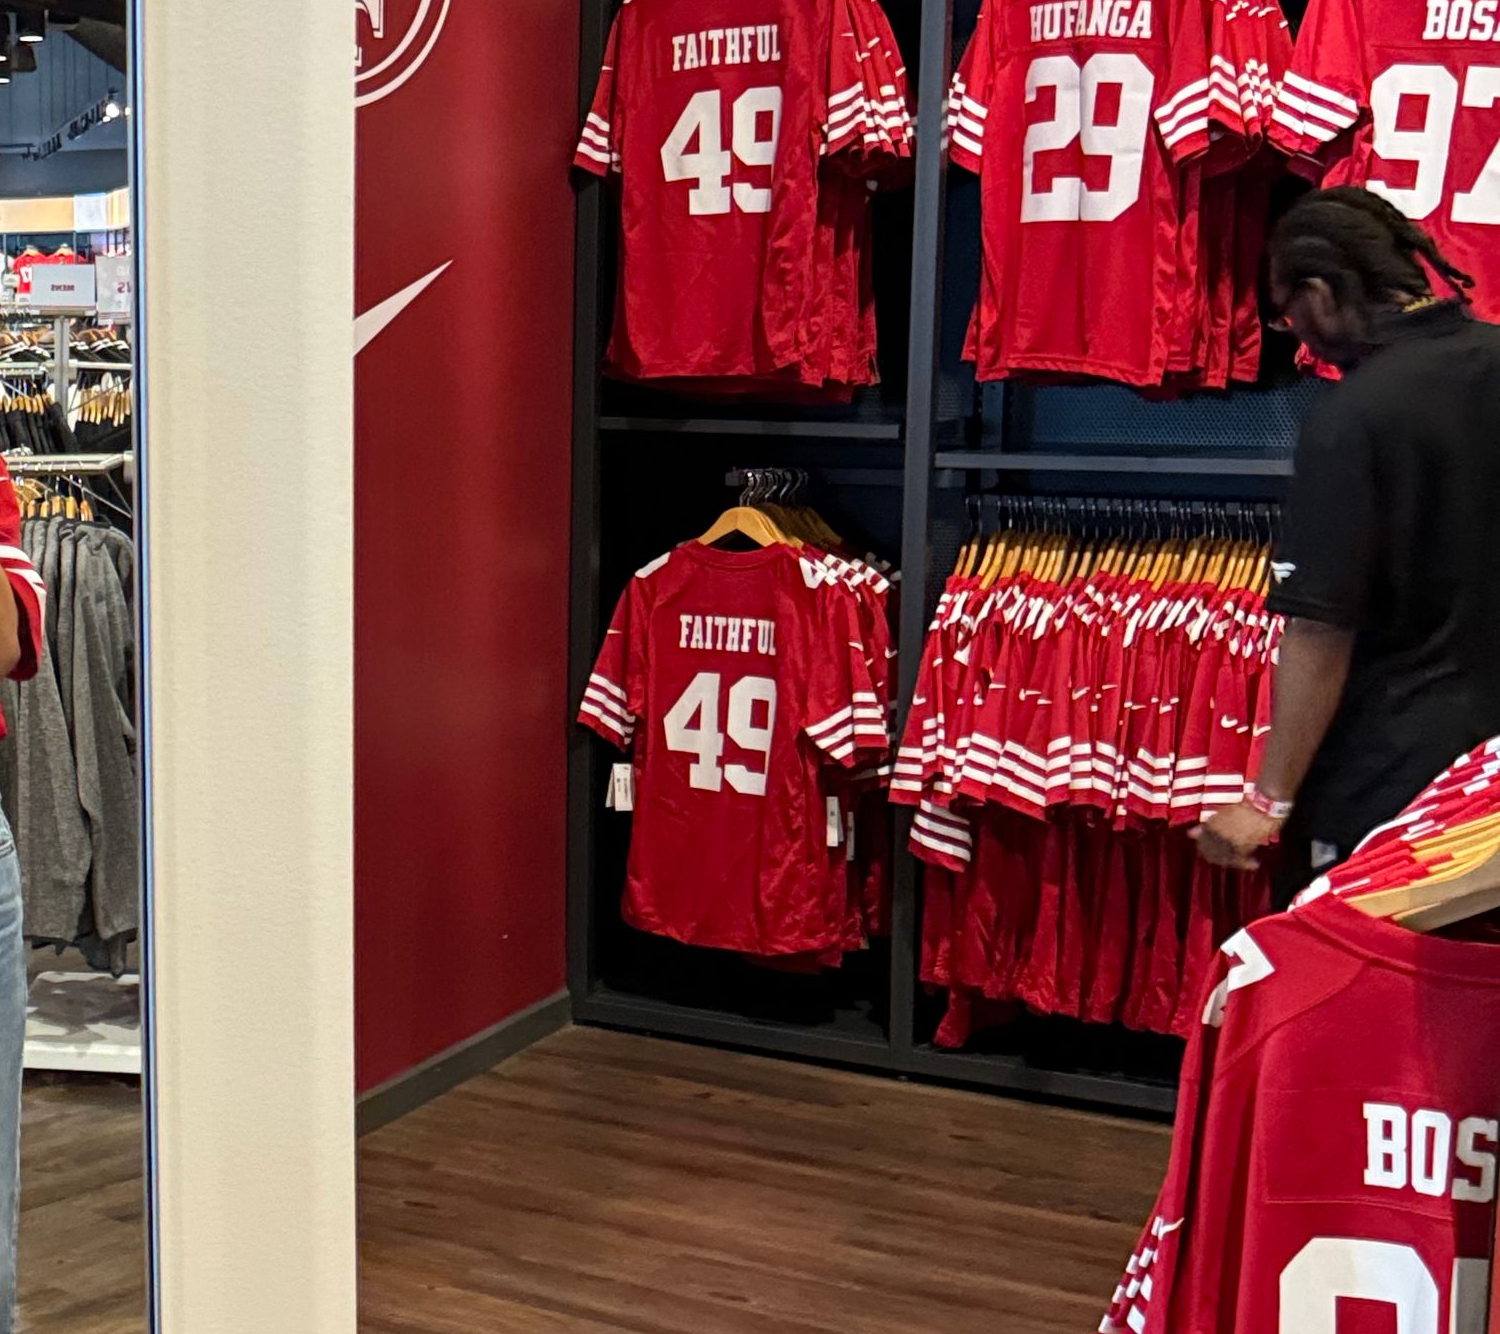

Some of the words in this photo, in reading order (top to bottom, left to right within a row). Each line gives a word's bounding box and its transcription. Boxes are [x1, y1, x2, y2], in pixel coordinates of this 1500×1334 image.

[672, 23, 781, 73] FAITHFUL
[1029, 0, 1152, 43] HUFANGA
[660, 85, 783, 216] 49
[1020, 53, 1155, 223] 29
[679, 613, 776, 657] FAITHFUL
[663, 671, 777, 797] 49
